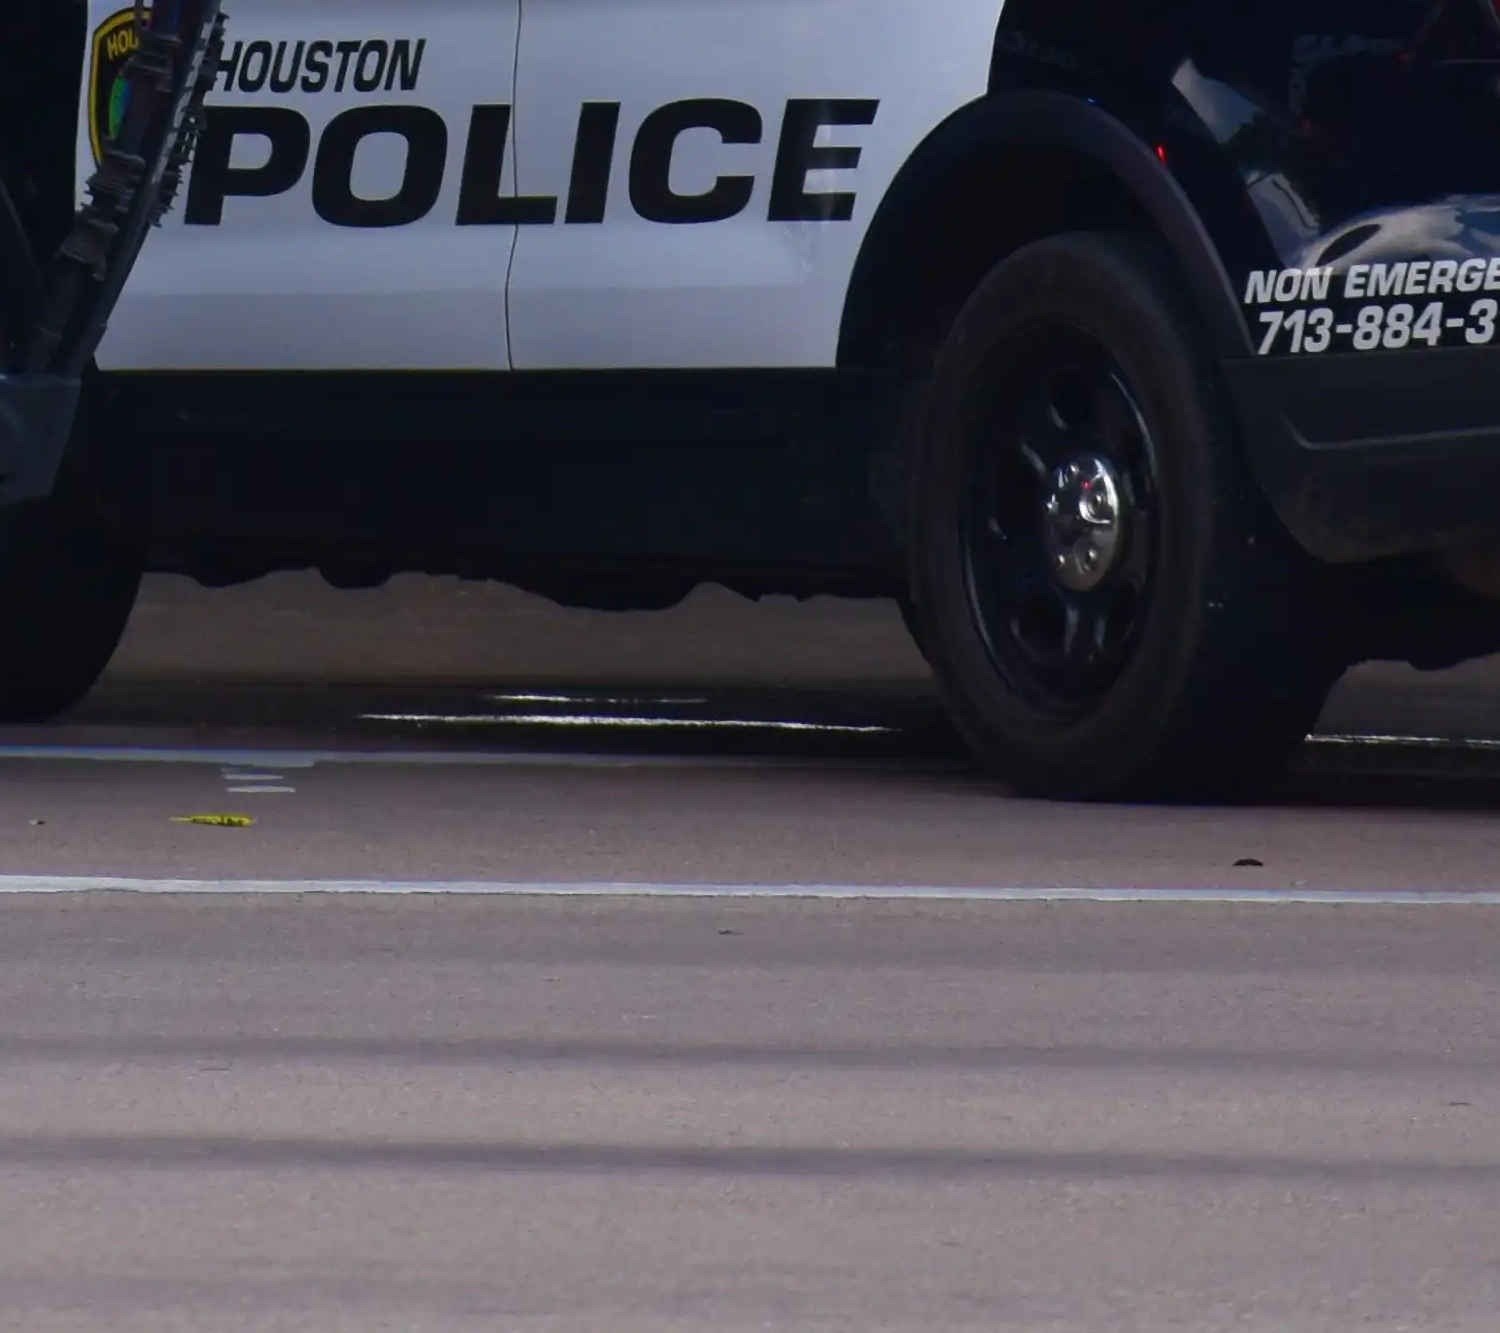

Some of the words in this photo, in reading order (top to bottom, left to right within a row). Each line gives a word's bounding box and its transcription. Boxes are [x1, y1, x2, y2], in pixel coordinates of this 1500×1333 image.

[205, 38, 427, 93] HOUSTON
[184, 99, 878, 228] POLICE
[1244, 266, 1335, 304] NON
